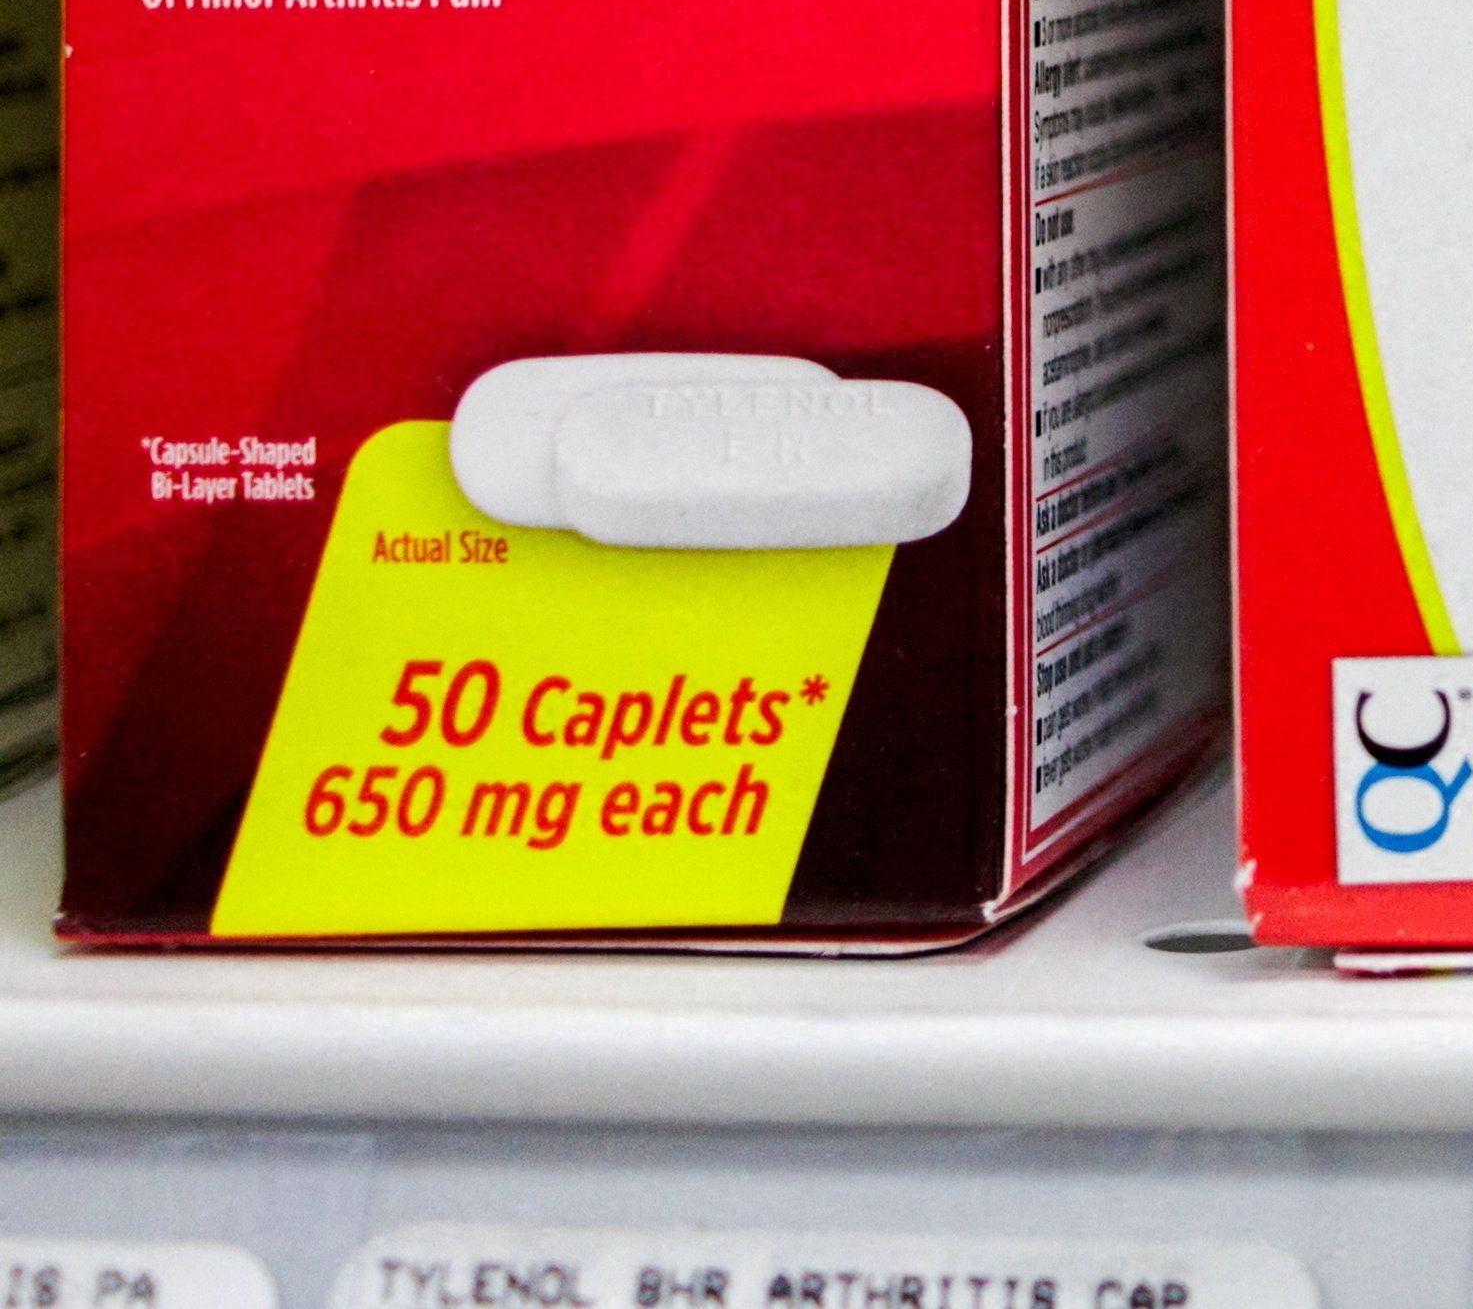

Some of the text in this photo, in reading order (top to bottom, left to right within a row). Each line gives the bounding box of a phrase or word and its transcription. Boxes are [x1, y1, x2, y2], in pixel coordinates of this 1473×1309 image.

[372, 531, 509, 564] Actual Size
[380, 660, 501, 747] 50
[304, 763, 769, 850] 650 mg each
[1356, 692, 1472, 853] QC
[380, 1258, 592, 1307] TYLENOL
